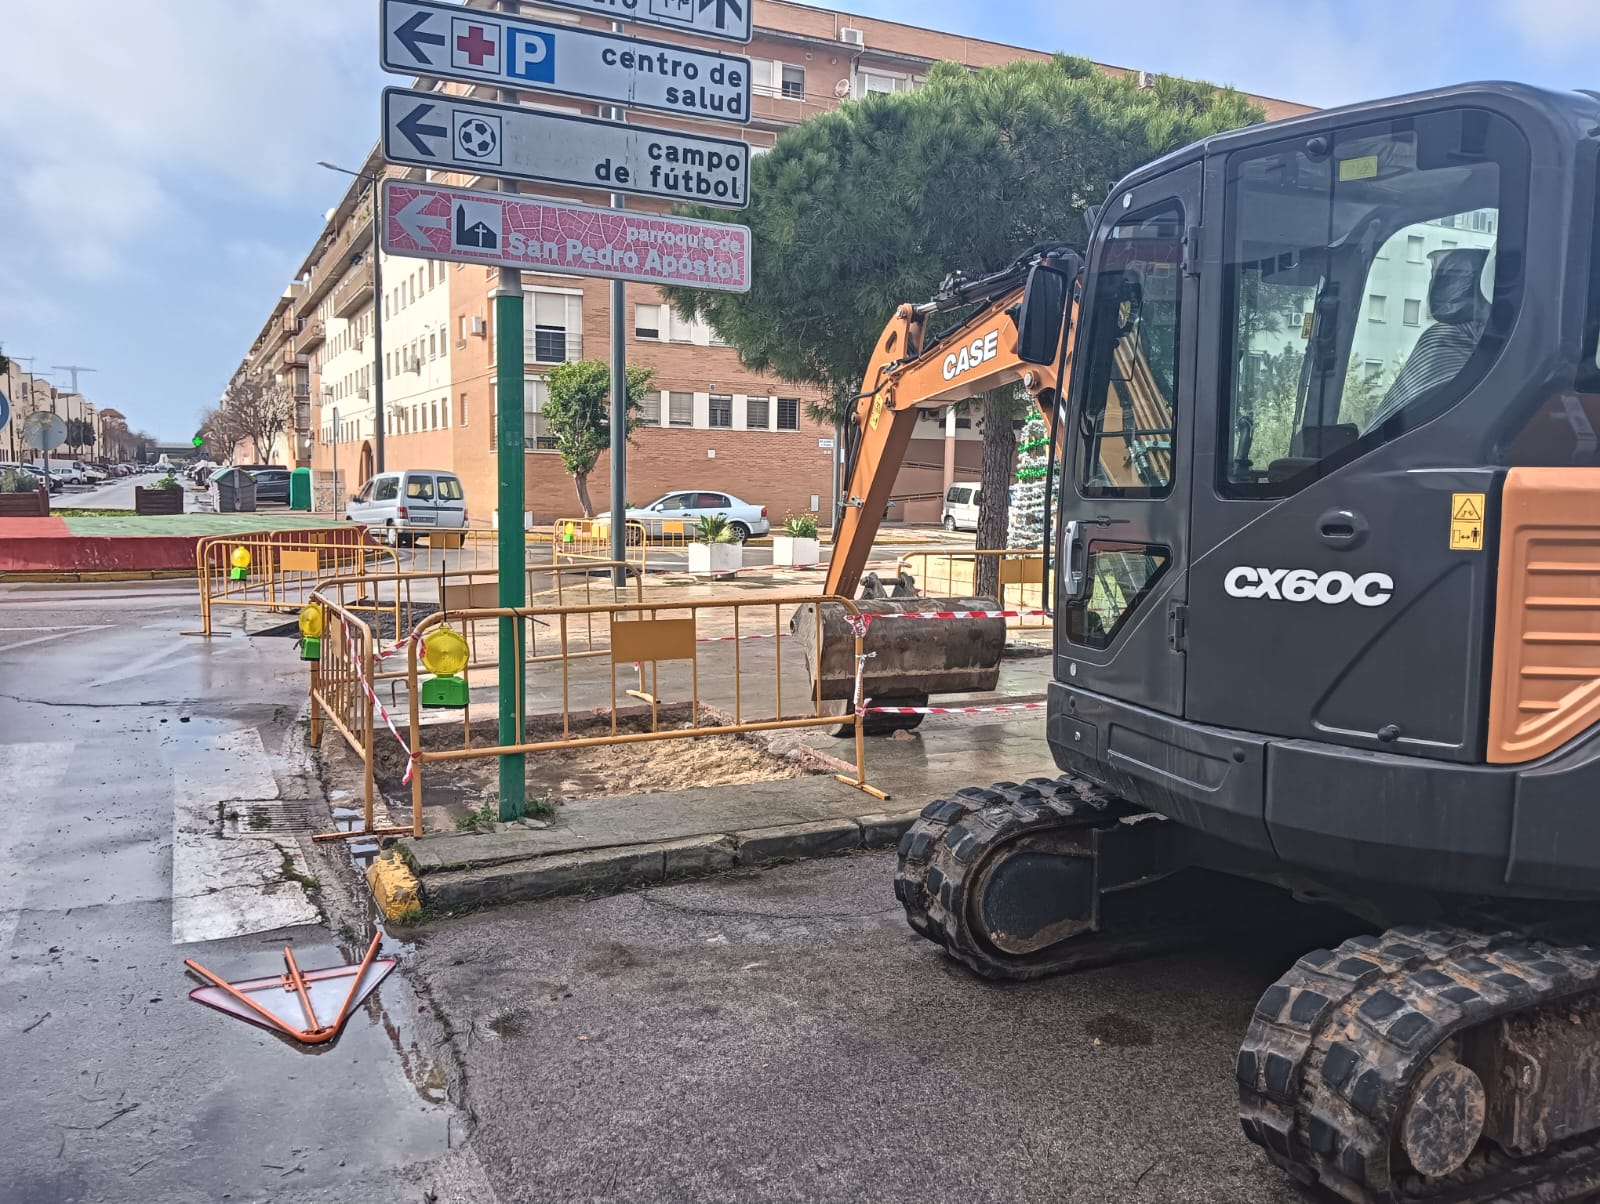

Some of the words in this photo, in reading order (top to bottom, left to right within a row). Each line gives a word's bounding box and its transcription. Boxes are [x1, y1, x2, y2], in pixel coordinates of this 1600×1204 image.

[515, 31, 547, 75] P
[602, 48, 699, 80] centro
[709, 63, 742, 87] de
[665, 86, 742, 114] salud
[648, 142, 740, 172] campo
[595, 158, 630, 183] de
[650, 165, 739, 199] fútbol
[509, 232, 558, 260] San
[567, 238, 638, 268] Pedro
[627, 226, 714, 250] parroquia
[719, 236, 741, 252] de
[942, 328, 999, 381] CASE
[1223, 566, 1394, 607] CX60C
